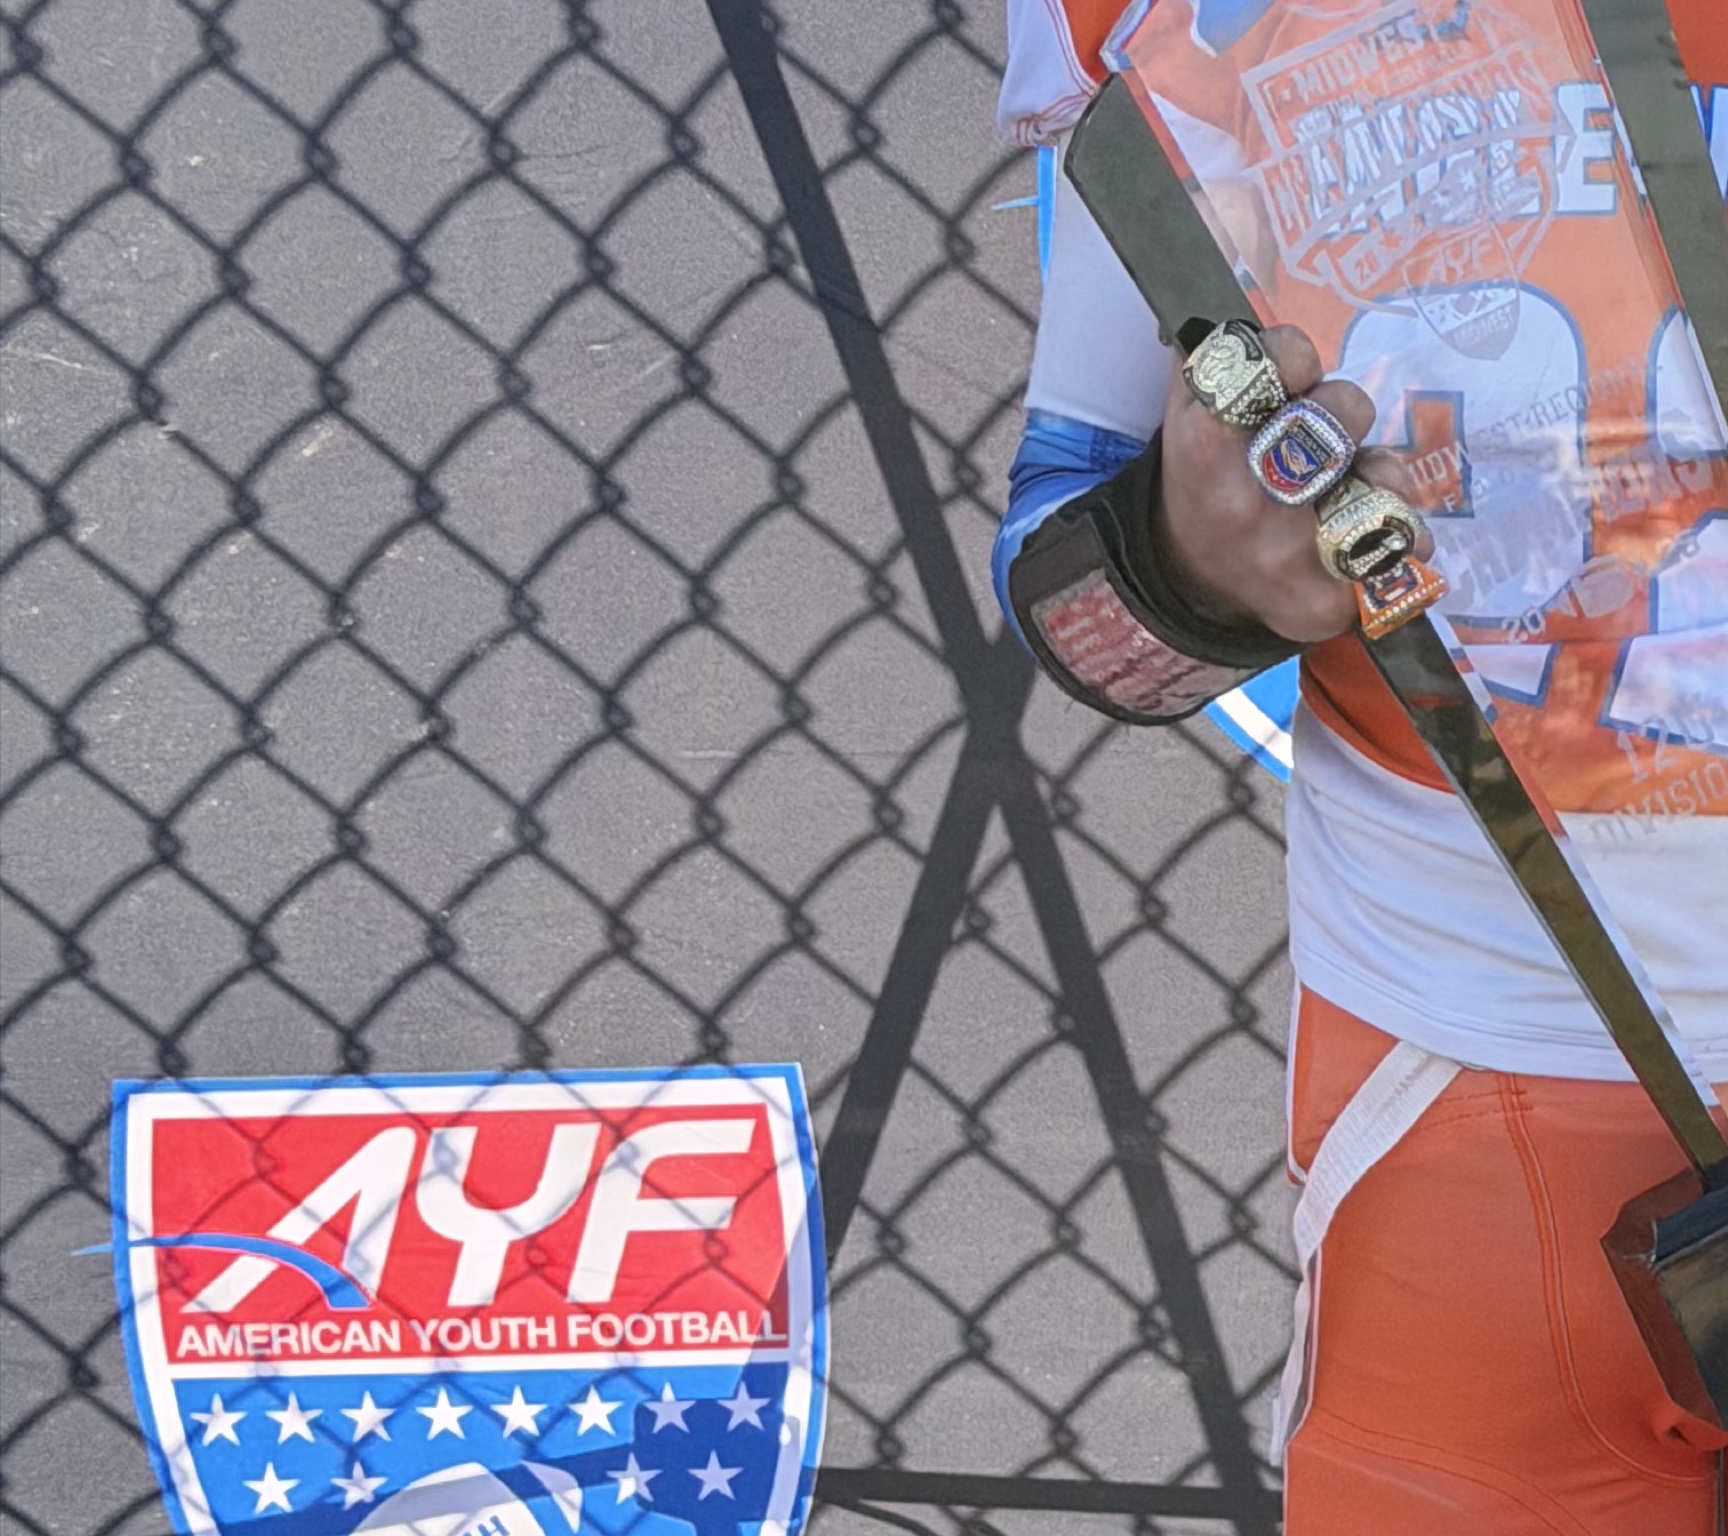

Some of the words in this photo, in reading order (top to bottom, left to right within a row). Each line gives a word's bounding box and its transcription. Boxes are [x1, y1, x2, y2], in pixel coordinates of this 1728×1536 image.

[180, 1118, 757, 1314] AYF
[176, 1318, 400, 1360] AMERICAN
[408, 1314, 557, 1353] YOUTH
[568, 1310, 788, 1348] FOOTBALL
